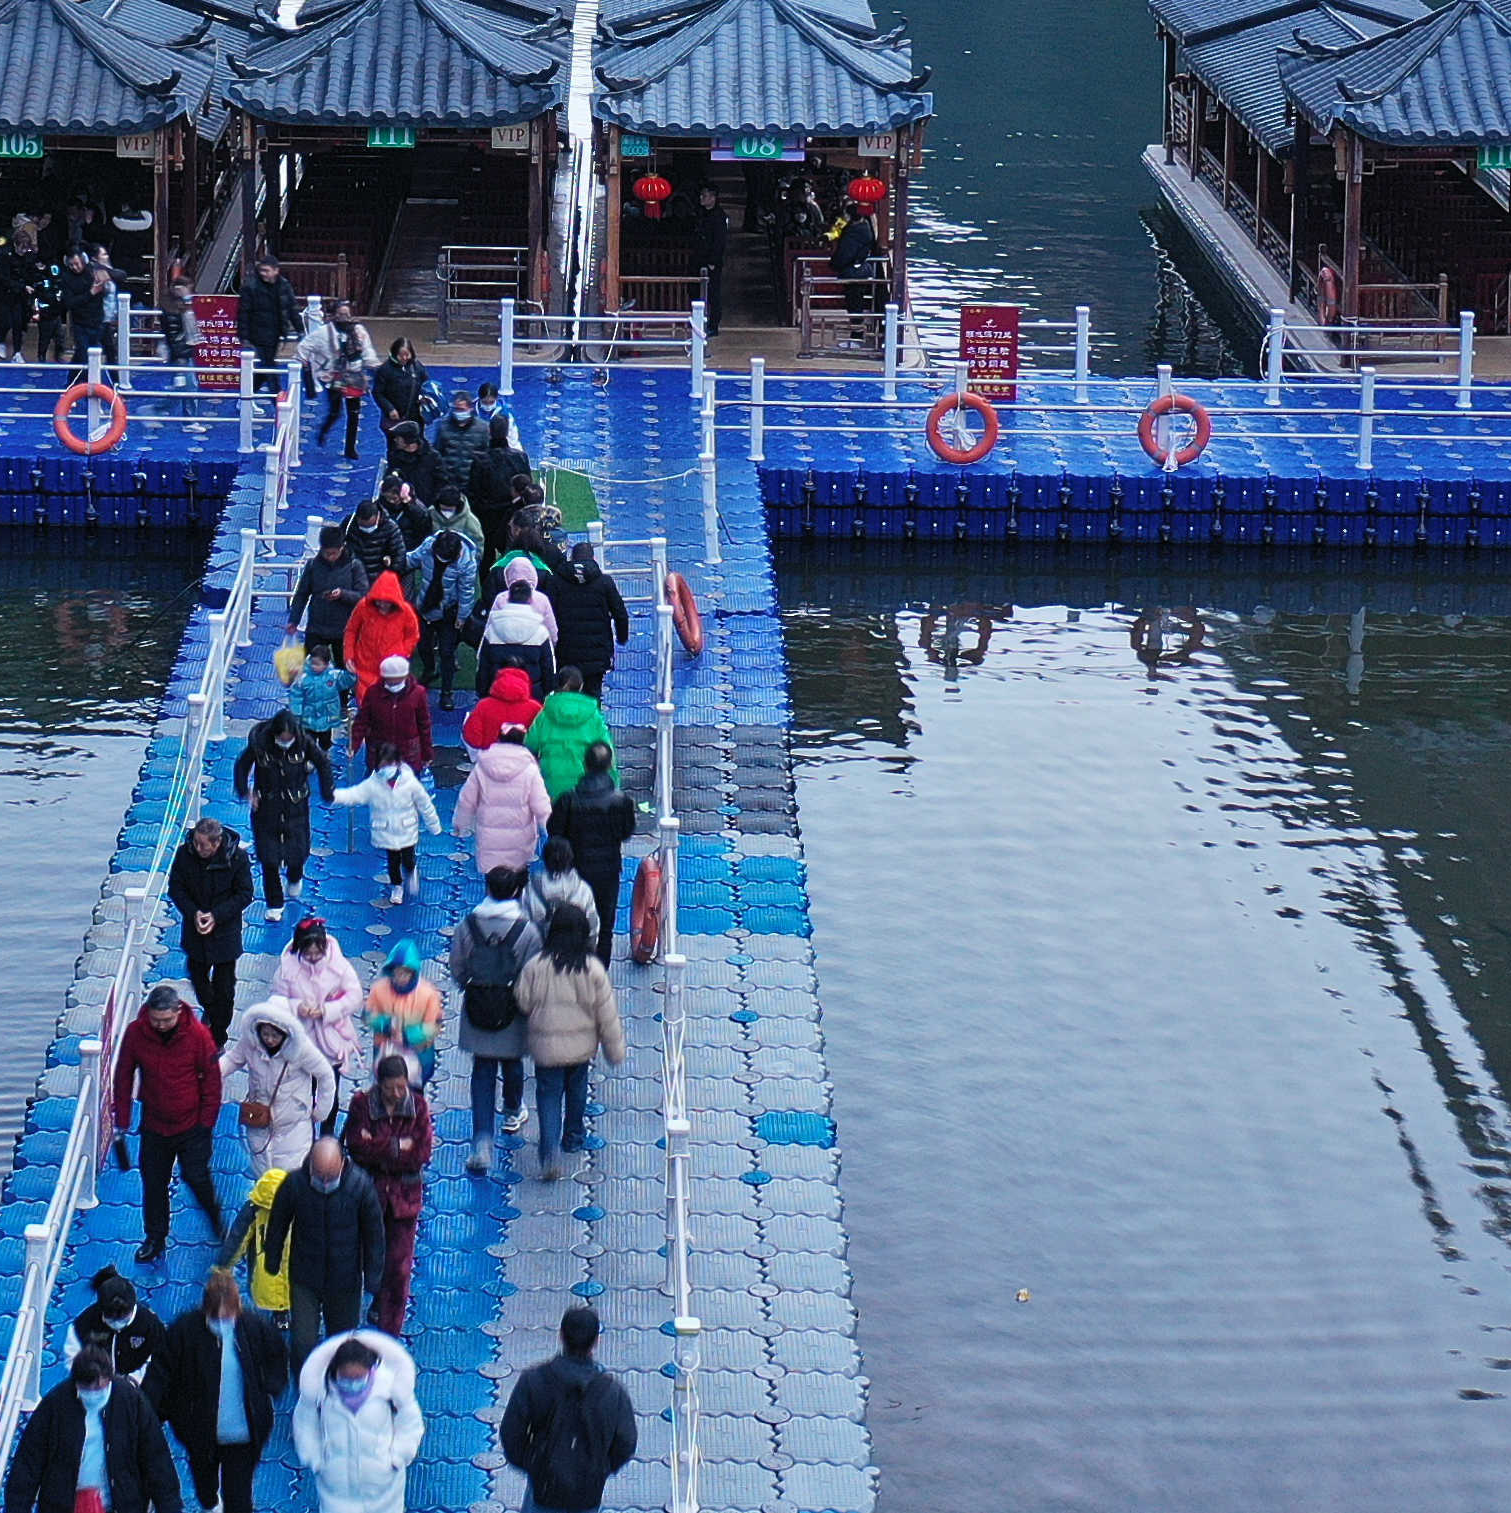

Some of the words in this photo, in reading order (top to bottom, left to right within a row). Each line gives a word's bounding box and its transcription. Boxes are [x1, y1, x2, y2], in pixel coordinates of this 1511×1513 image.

[496, 128, 525, 142] VIP
[121, 137, 150, 151] VIP
[741, 135, 777, 156] 08
[863, 135, 892, 150] VIP
